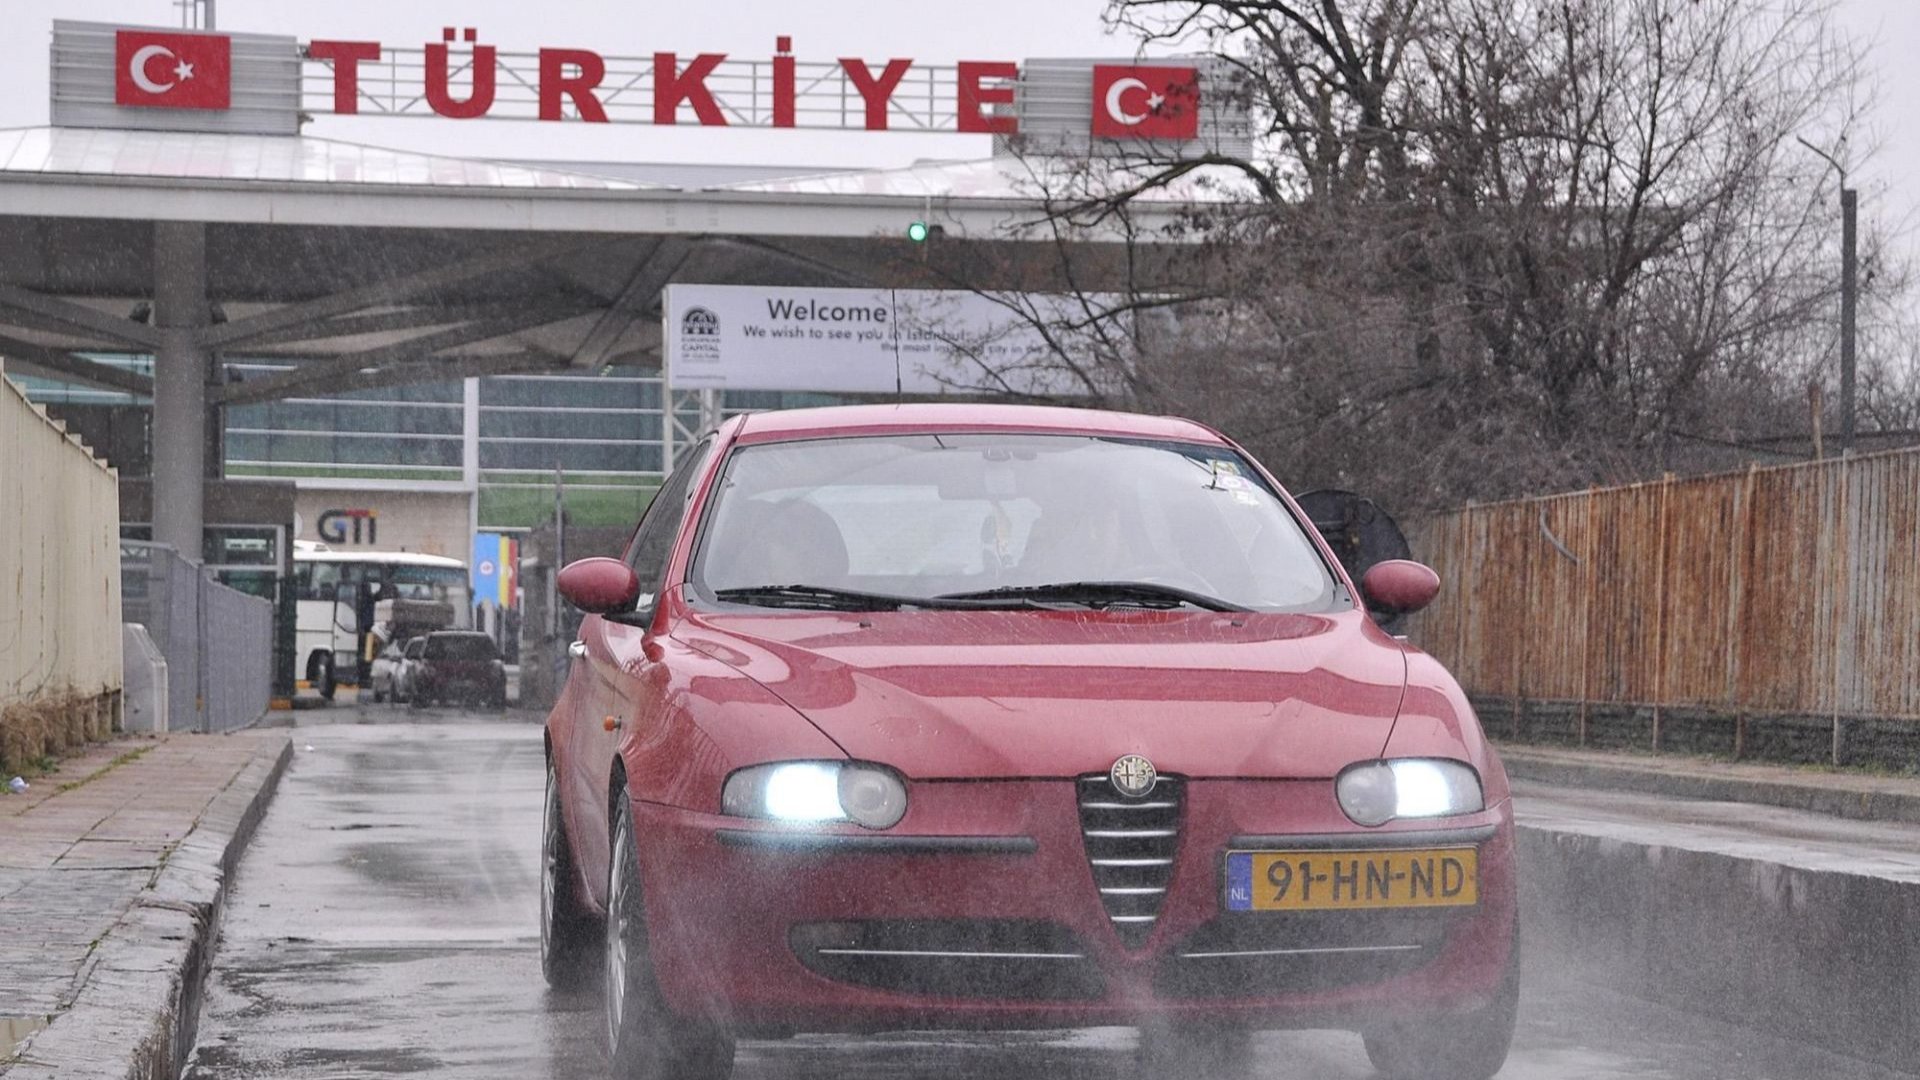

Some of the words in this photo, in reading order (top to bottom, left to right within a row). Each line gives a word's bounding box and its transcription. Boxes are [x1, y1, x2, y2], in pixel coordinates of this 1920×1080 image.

[311, 27, 1018, 133] TÜRKİYE
[767, 298, 888, 322] Welcome
[743, 325, 766, 338] We
[771, 325, 804, 339] wish
[809, 327, 823, 339] to
[828, 331, 852, 339] see
[857, 330, 883, 343] you
[318, 509, 377, 544] GTI
[1267, 857, 1465, 902] 91-HN-ND
[1231, 888, 1249, 901] NL
